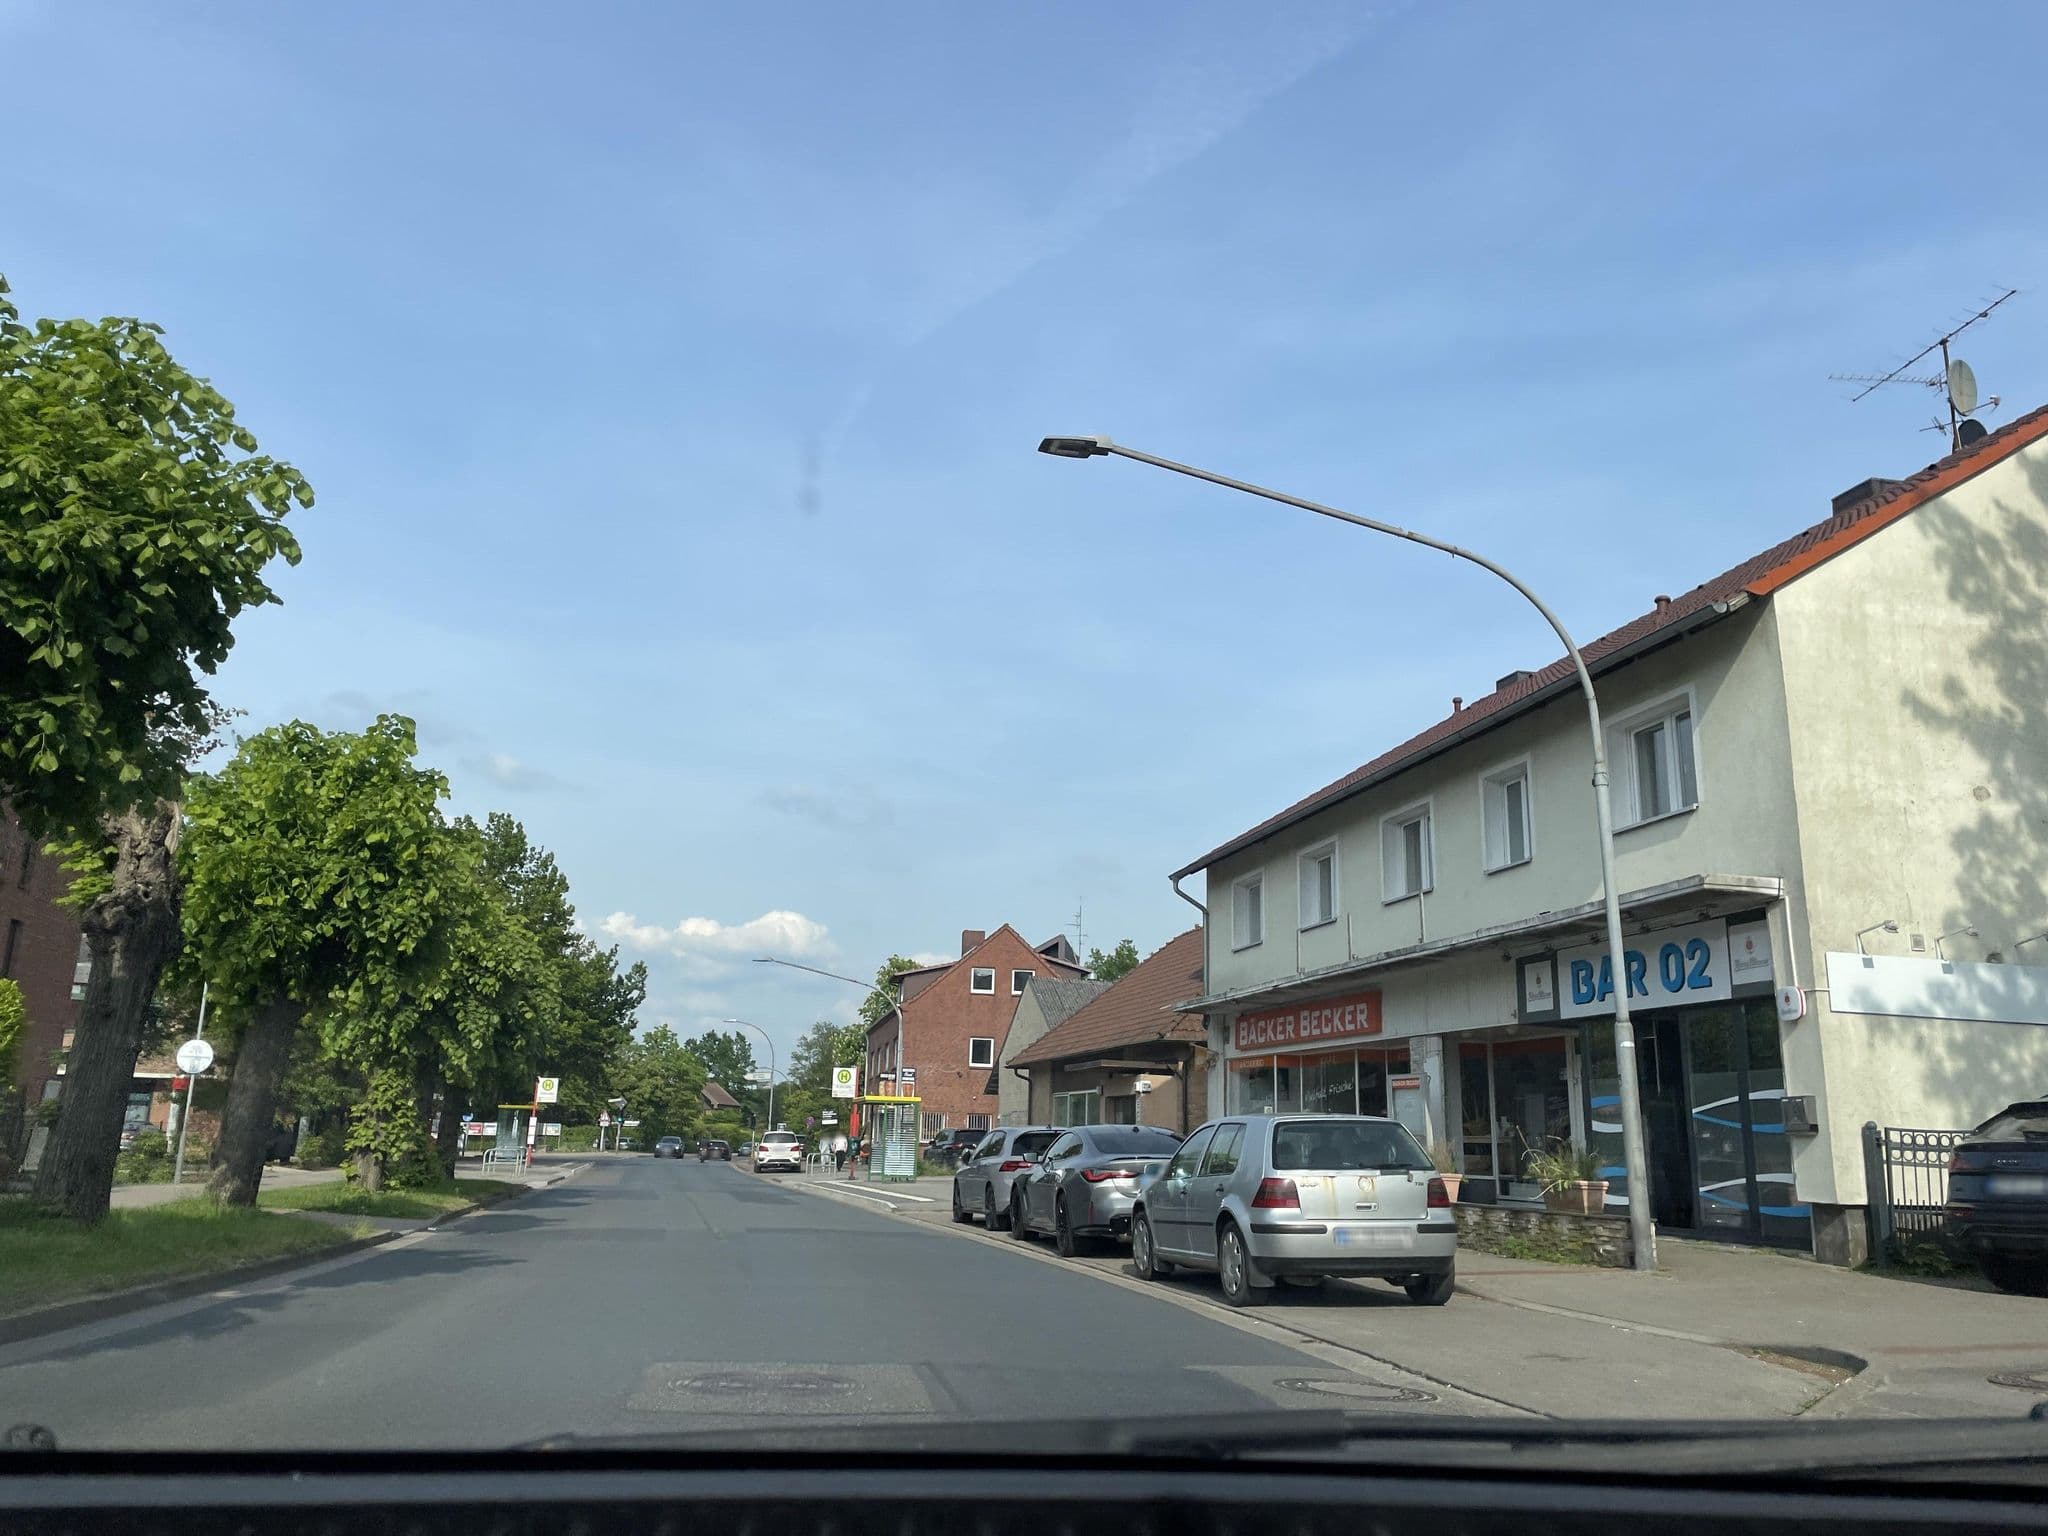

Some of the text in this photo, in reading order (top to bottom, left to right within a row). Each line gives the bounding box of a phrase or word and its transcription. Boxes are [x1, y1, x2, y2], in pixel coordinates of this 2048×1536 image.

[1571, 937, 1712, 1005] BAR 02
[1239, 1003, 1369, 1046] BÄCKER BECKER
